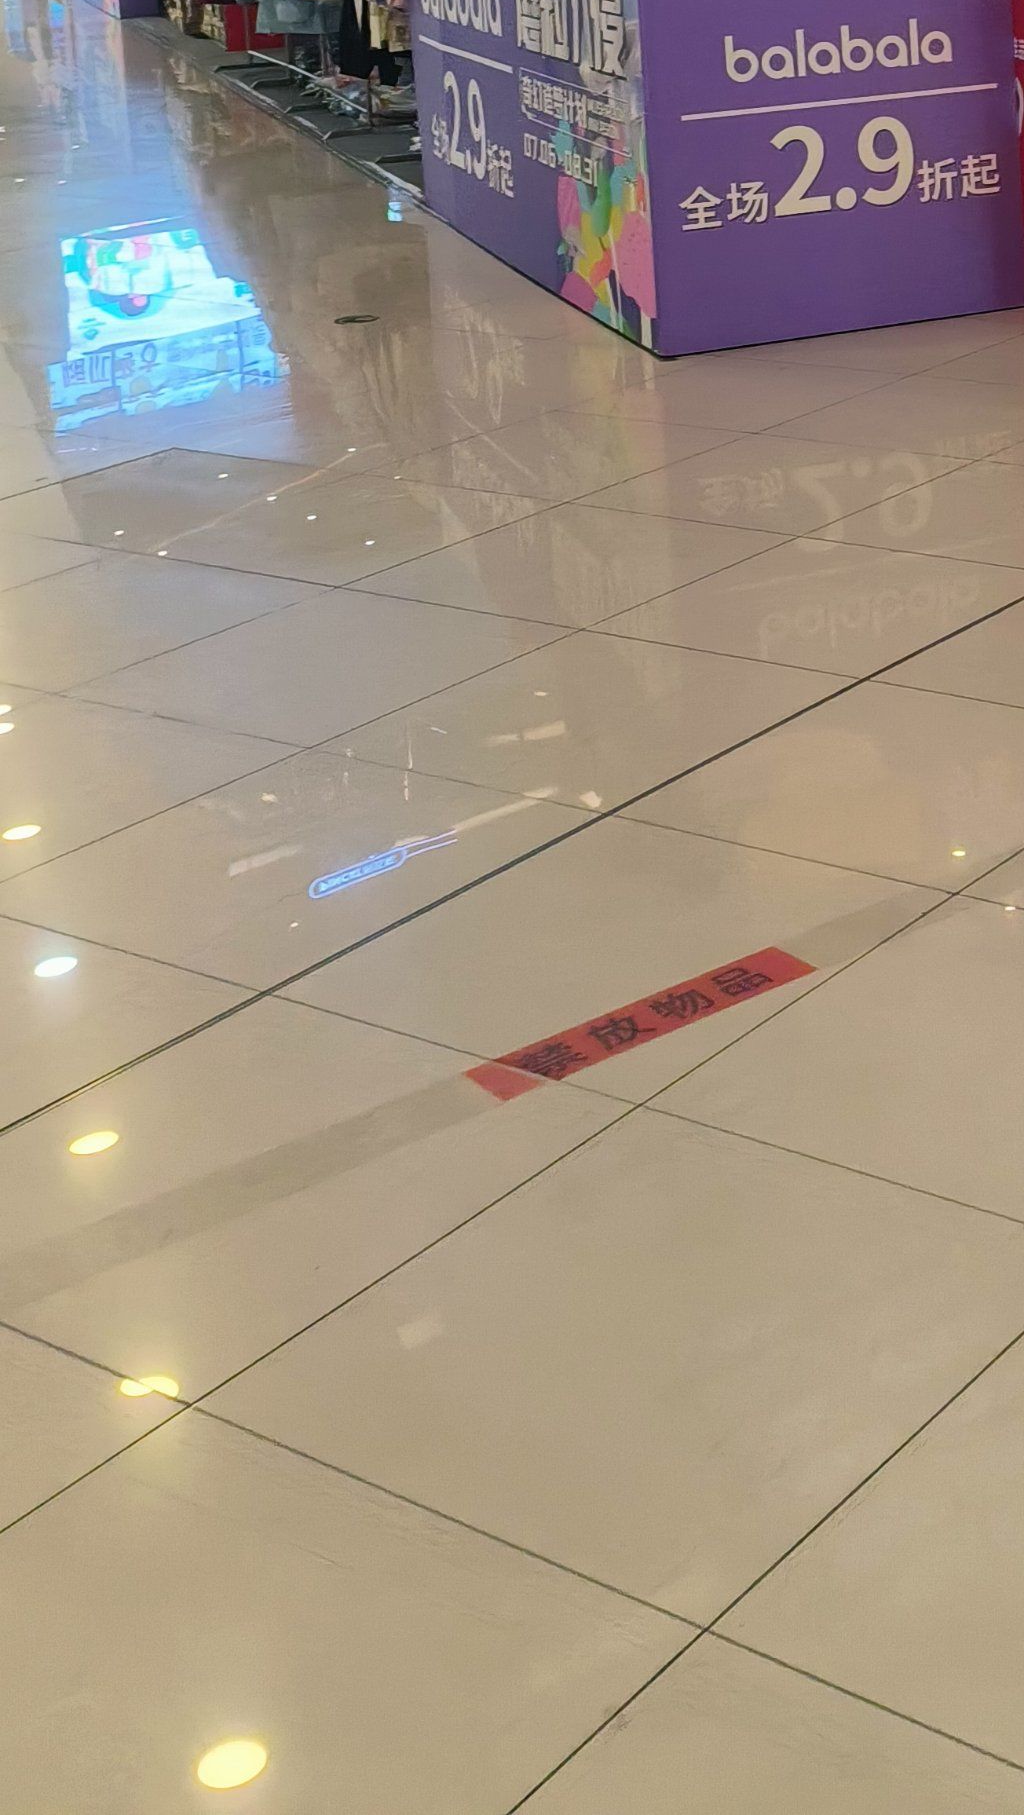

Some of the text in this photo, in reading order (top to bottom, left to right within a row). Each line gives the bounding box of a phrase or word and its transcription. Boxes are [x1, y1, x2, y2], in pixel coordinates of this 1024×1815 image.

[723, 18, 954, 83] balabala
[678, 115, 1001, 233] 全场2.9折起
